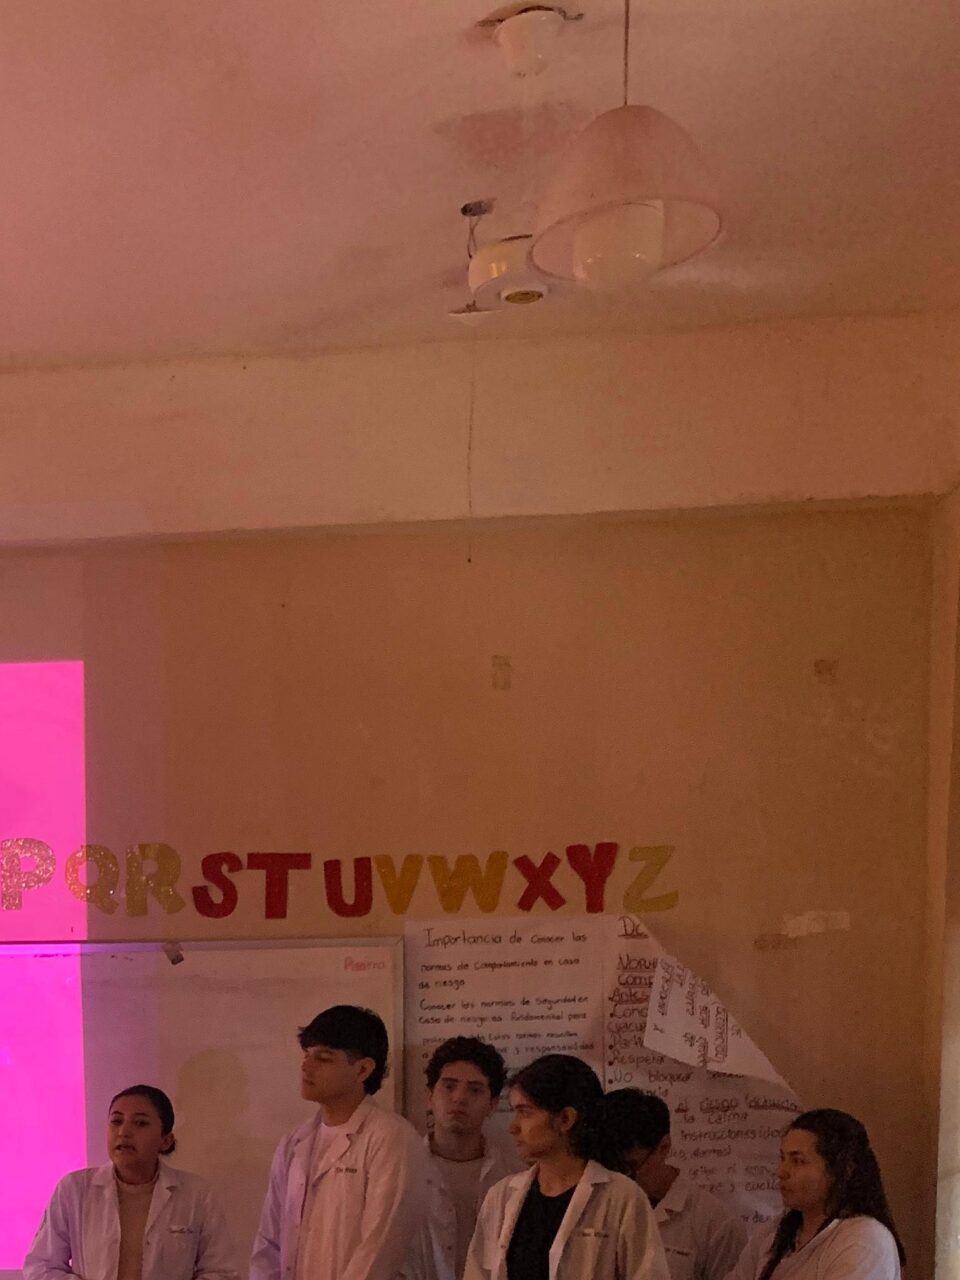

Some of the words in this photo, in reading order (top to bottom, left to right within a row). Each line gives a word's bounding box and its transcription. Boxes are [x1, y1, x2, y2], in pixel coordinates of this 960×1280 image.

[423, 928, 503, 949] Importancia
[509, 929, 522, 944] de
[572, 930, 588, 943] las
[457, 961, 469, 970] de
